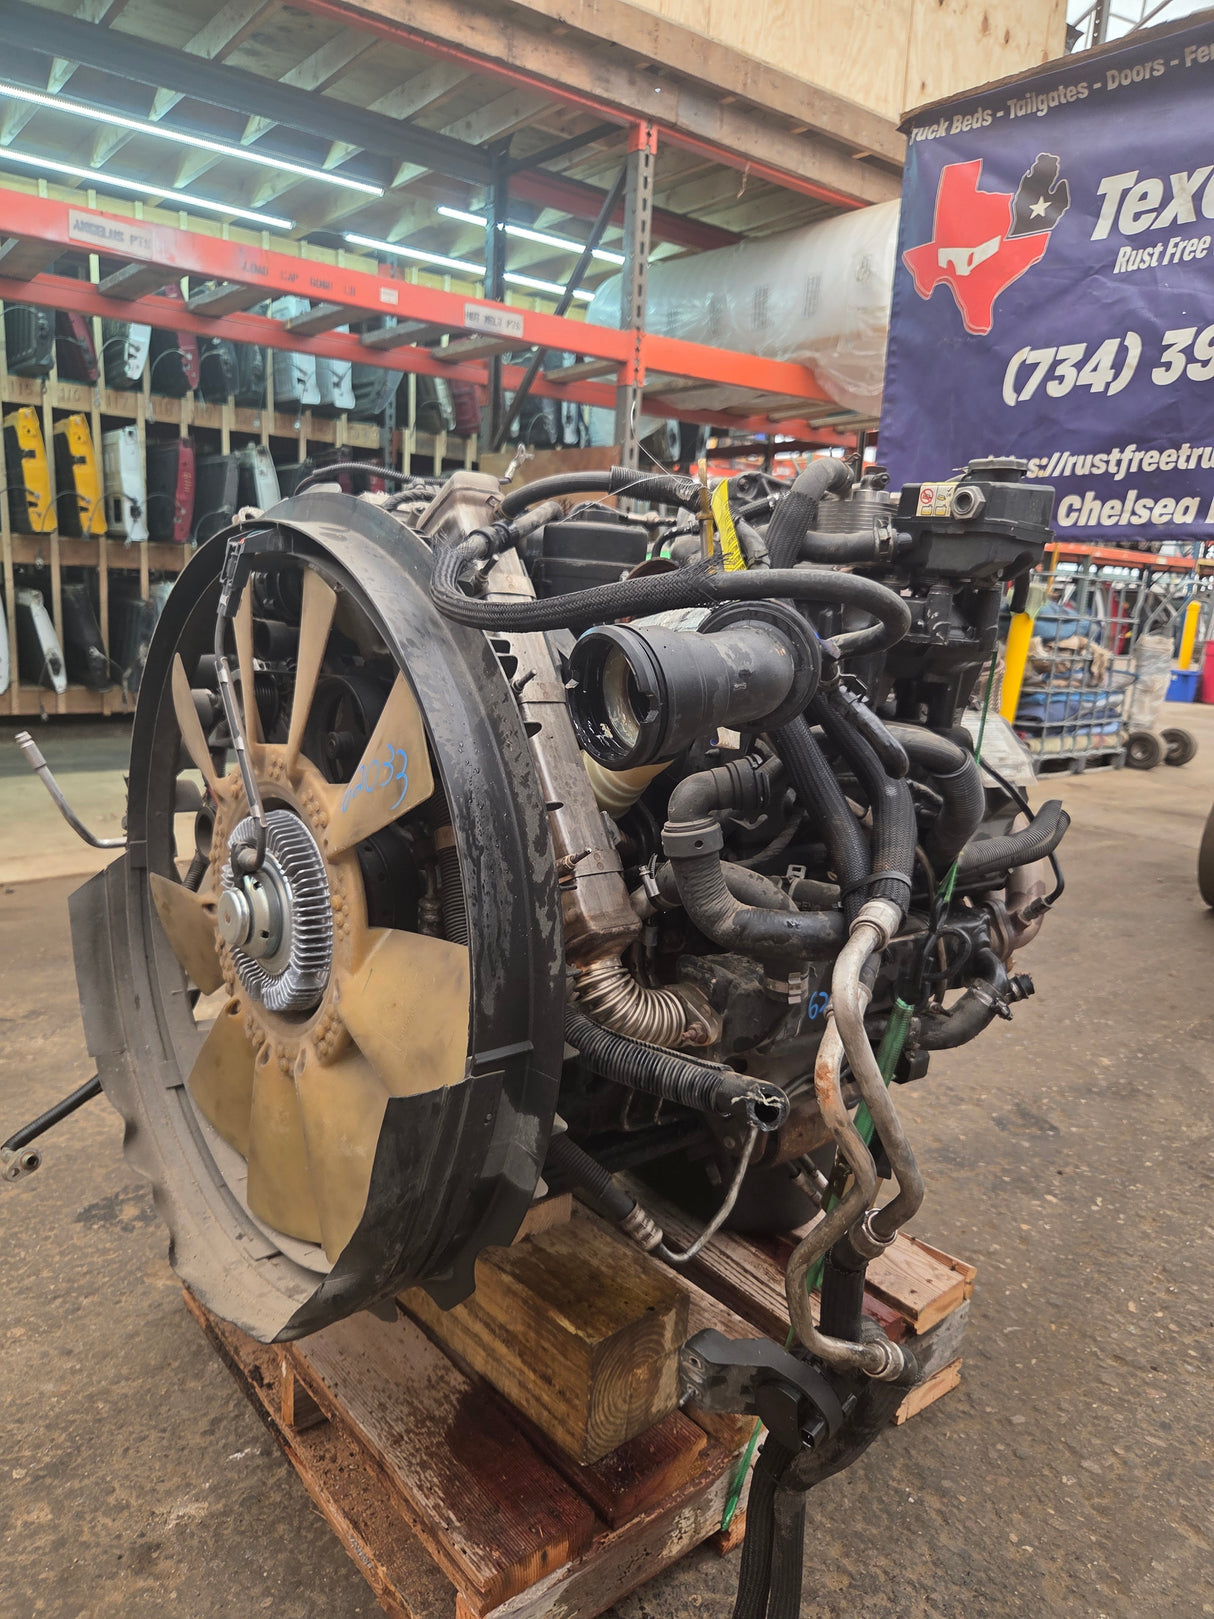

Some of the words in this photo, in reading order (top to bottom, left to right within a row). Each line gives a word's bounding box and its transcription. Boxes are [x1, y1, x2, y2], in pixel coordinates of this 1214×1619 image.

[908, 117, 950, 146] ruck
[950, 107, 993, 135] Beds
[1007, 80, 1089, 119] Tailgates
[1106, 57, 1165, 91] Doors
[1184, 43, 1214, 68] Fe
[1113, 242, 1164, 274] Rust
[1161, 235, 1212, 266] Free
[1002, 331, 1143, 407] (734)
[1057, 490, 1201, 526] Chelsea
